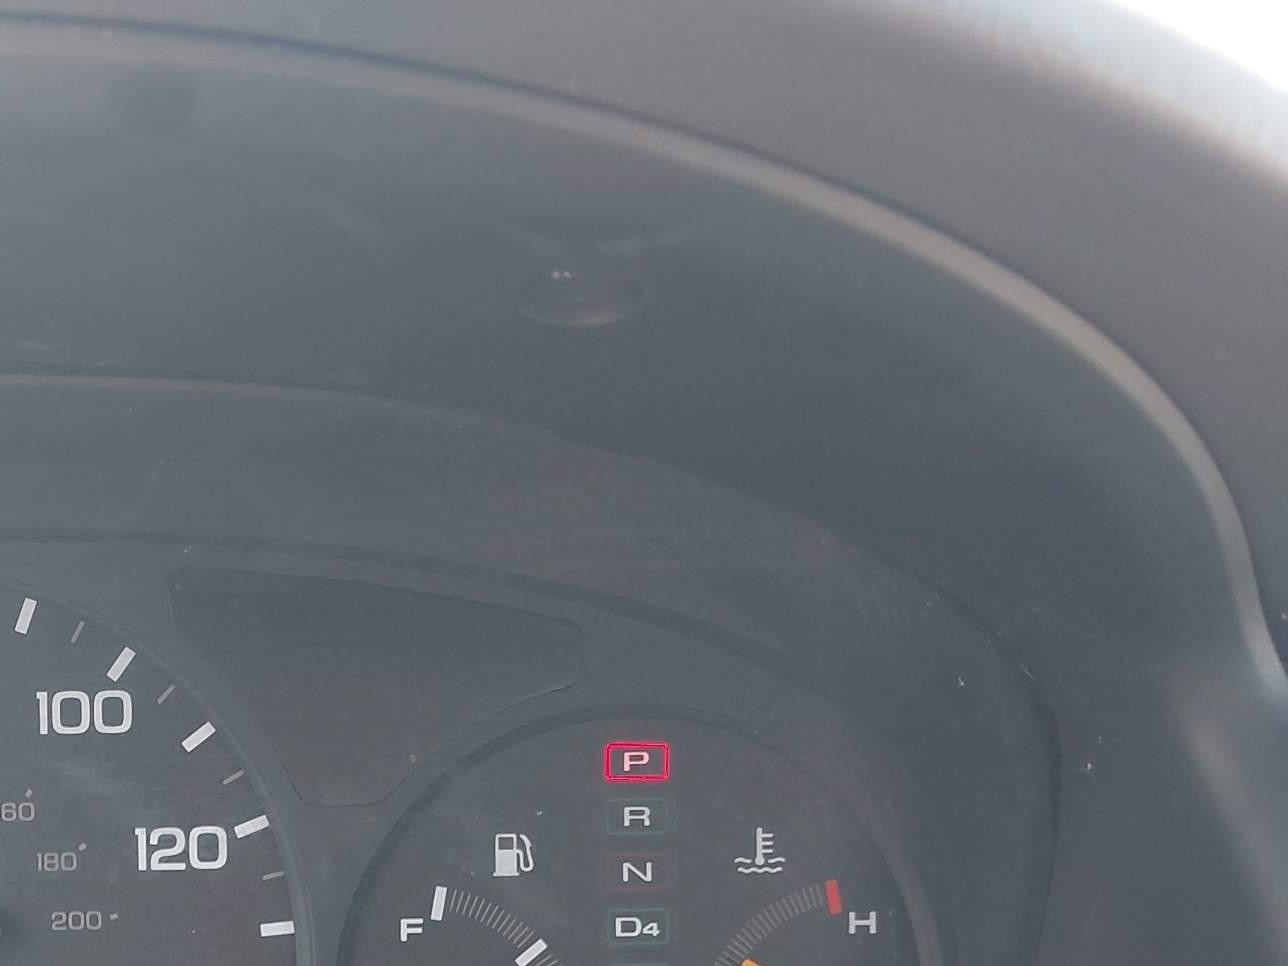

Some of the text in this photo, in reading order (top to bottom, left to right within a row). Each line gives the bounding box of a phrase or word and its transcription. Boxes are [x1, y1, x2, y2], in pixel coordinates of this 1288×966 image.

[36, 690, 133, 735] 100
[623, 752, 650, 772] P
[623, 807, 651, 827] R
[135, 826, 227, 871] 120
[37, 852, 77, 872] 180
[622, 862, 653, 882] N
[51, 911, 102, 931] 200
[400, 918, 424, 942] F
[615, 918, 661, 938] D4
[848, 911, 877, 934] H
